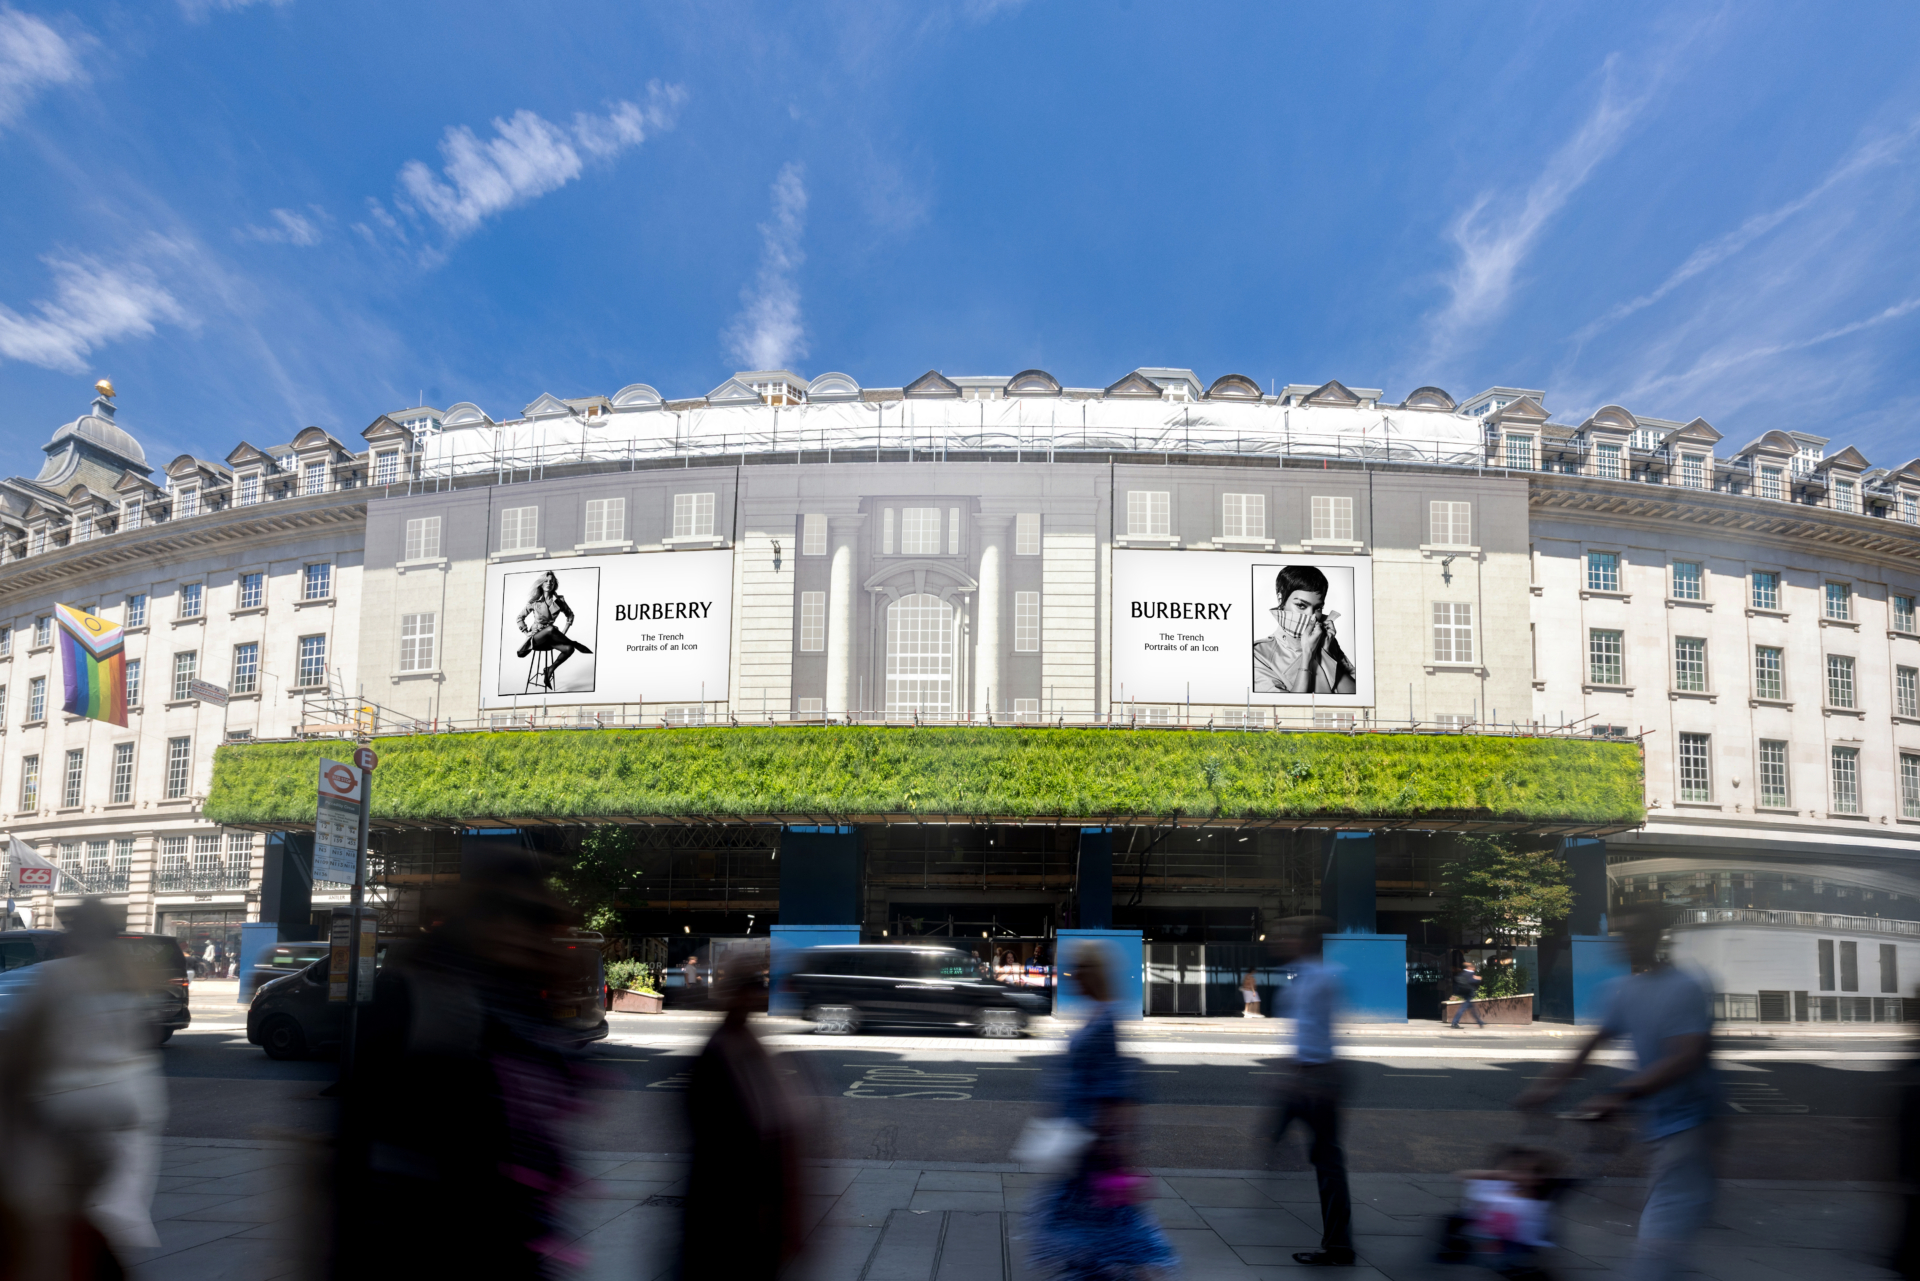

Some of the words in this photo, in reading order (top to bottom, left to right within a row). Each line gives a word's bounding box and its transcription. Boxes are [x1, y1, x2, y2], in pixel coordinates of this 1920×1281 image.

[616, 602, 712, 621] BURBERRY
[1131, 602, 1232, 620] BURBERRY
[641, 633, 655, 641] The
[658, 633, 684, 641] Trench
[1144, 643, 1177, 651] Portraits
[362, 750, 372, 768] E
